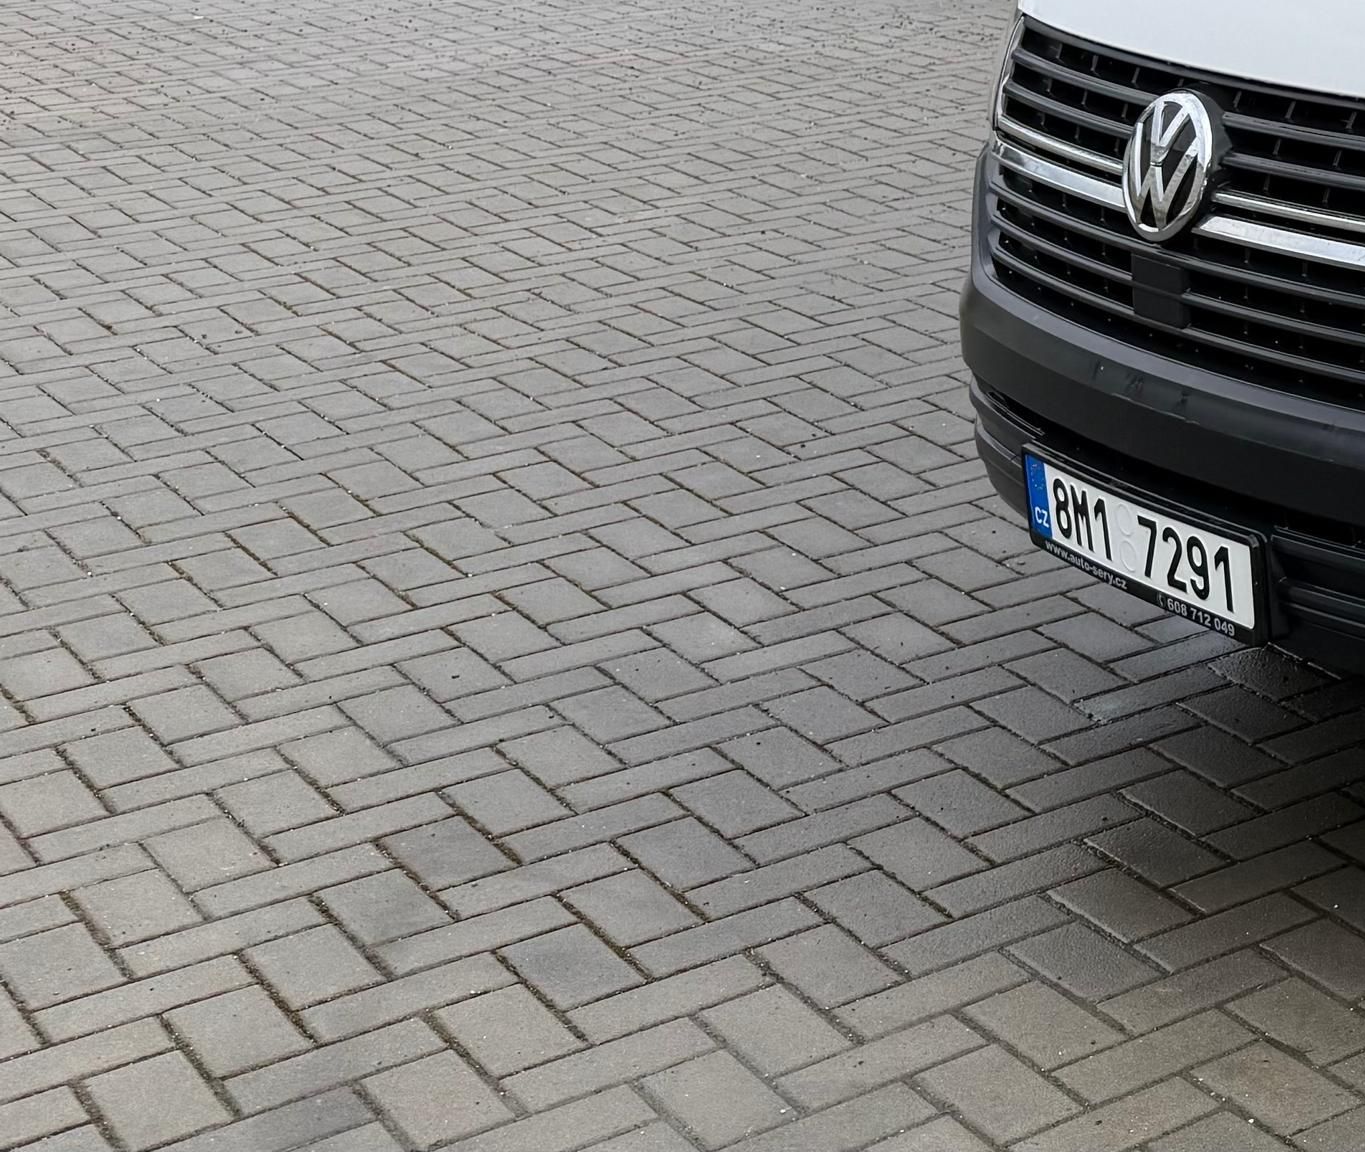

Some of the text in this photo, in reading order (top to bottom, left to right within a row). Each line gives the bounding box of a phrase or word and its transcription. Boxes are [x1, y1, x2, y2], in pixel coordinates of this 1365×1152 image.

[1034, 505, 1050, 528] CZ
[1053, 478, 1234, 614] 8M1 7291
[1166, 598, 1236, 637] 608 712 049
